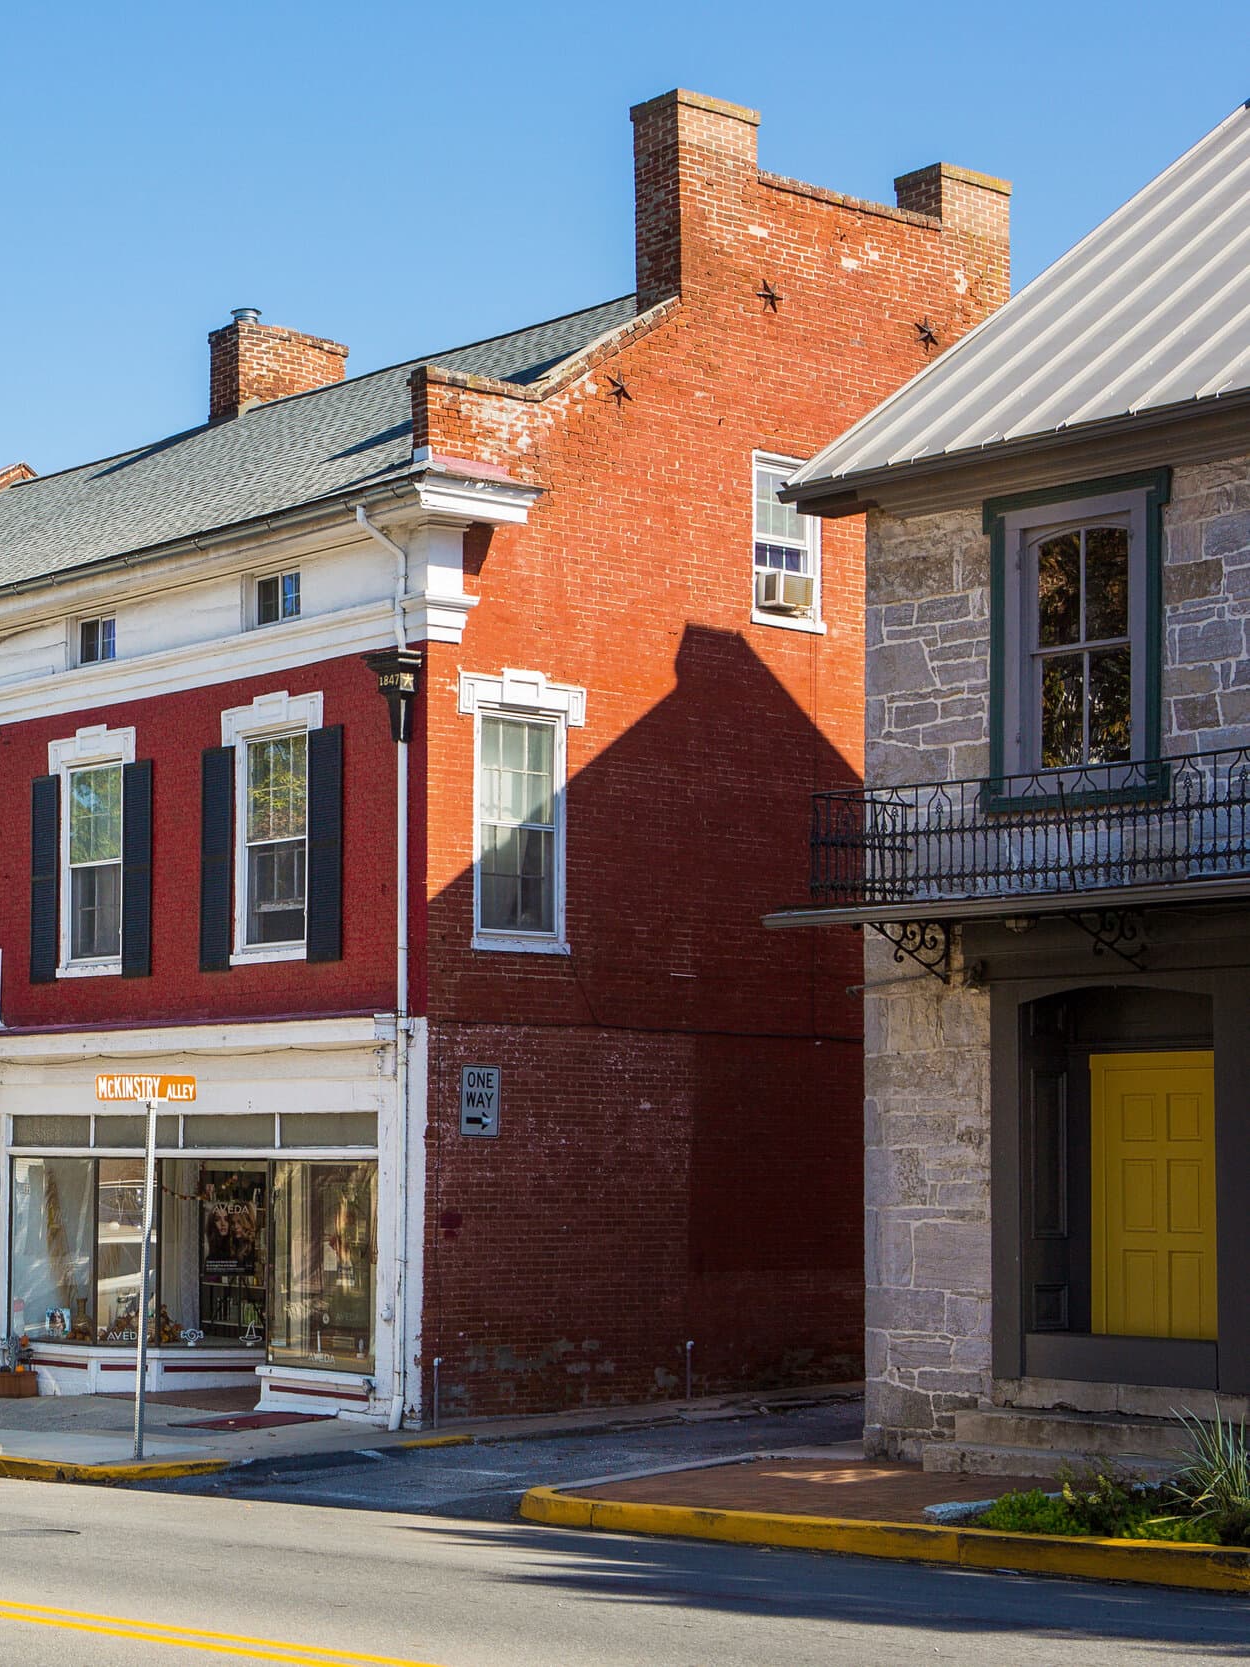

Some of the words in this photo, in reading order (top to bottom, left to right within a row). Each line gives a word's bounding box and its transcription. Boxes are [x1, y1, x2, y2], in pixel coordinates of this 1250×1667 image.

[379, 673, 400, 687] 1847
[467, 1071, 495, 1088] ONE
[167, 1083, 195, 1099] ALLEY
[466, 1091, 495, 1109] WAY
[212, 1203, 250, 1215] AVEDA
[107, 1331, 138, 1341] AVED
